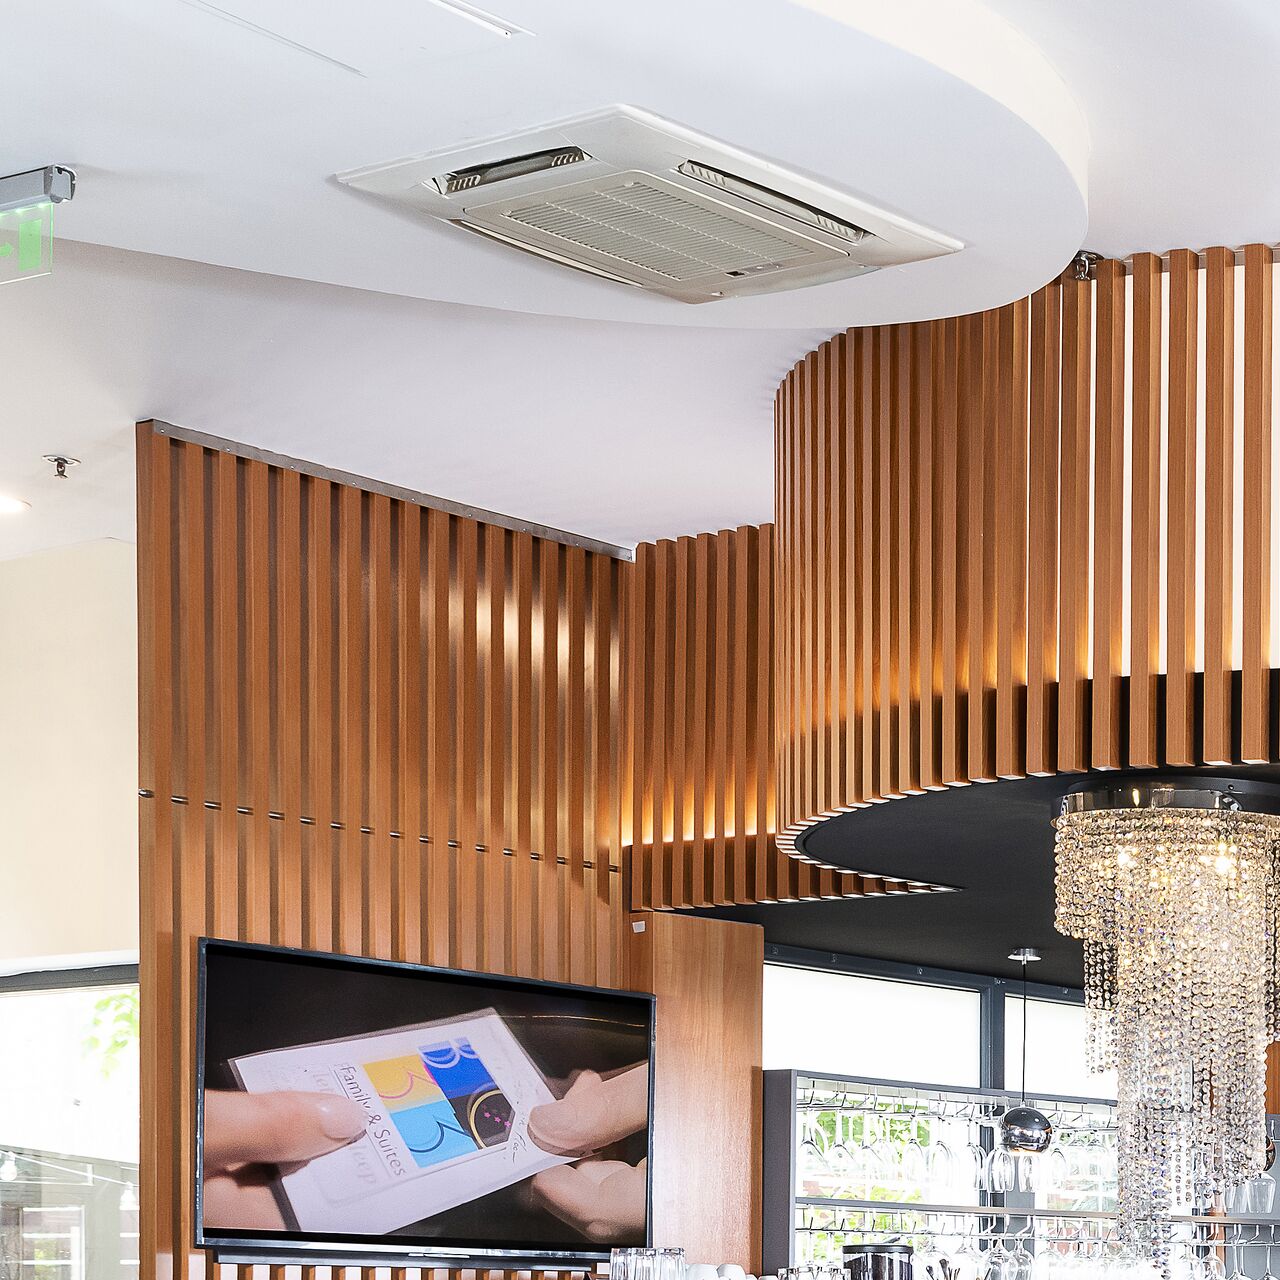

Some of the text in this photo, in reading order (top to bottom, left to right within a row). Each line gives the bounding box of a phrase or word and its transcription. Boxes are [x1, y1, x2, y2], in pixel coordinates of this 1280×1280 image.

[340, 1066, 407, 1178] Family & Suites
